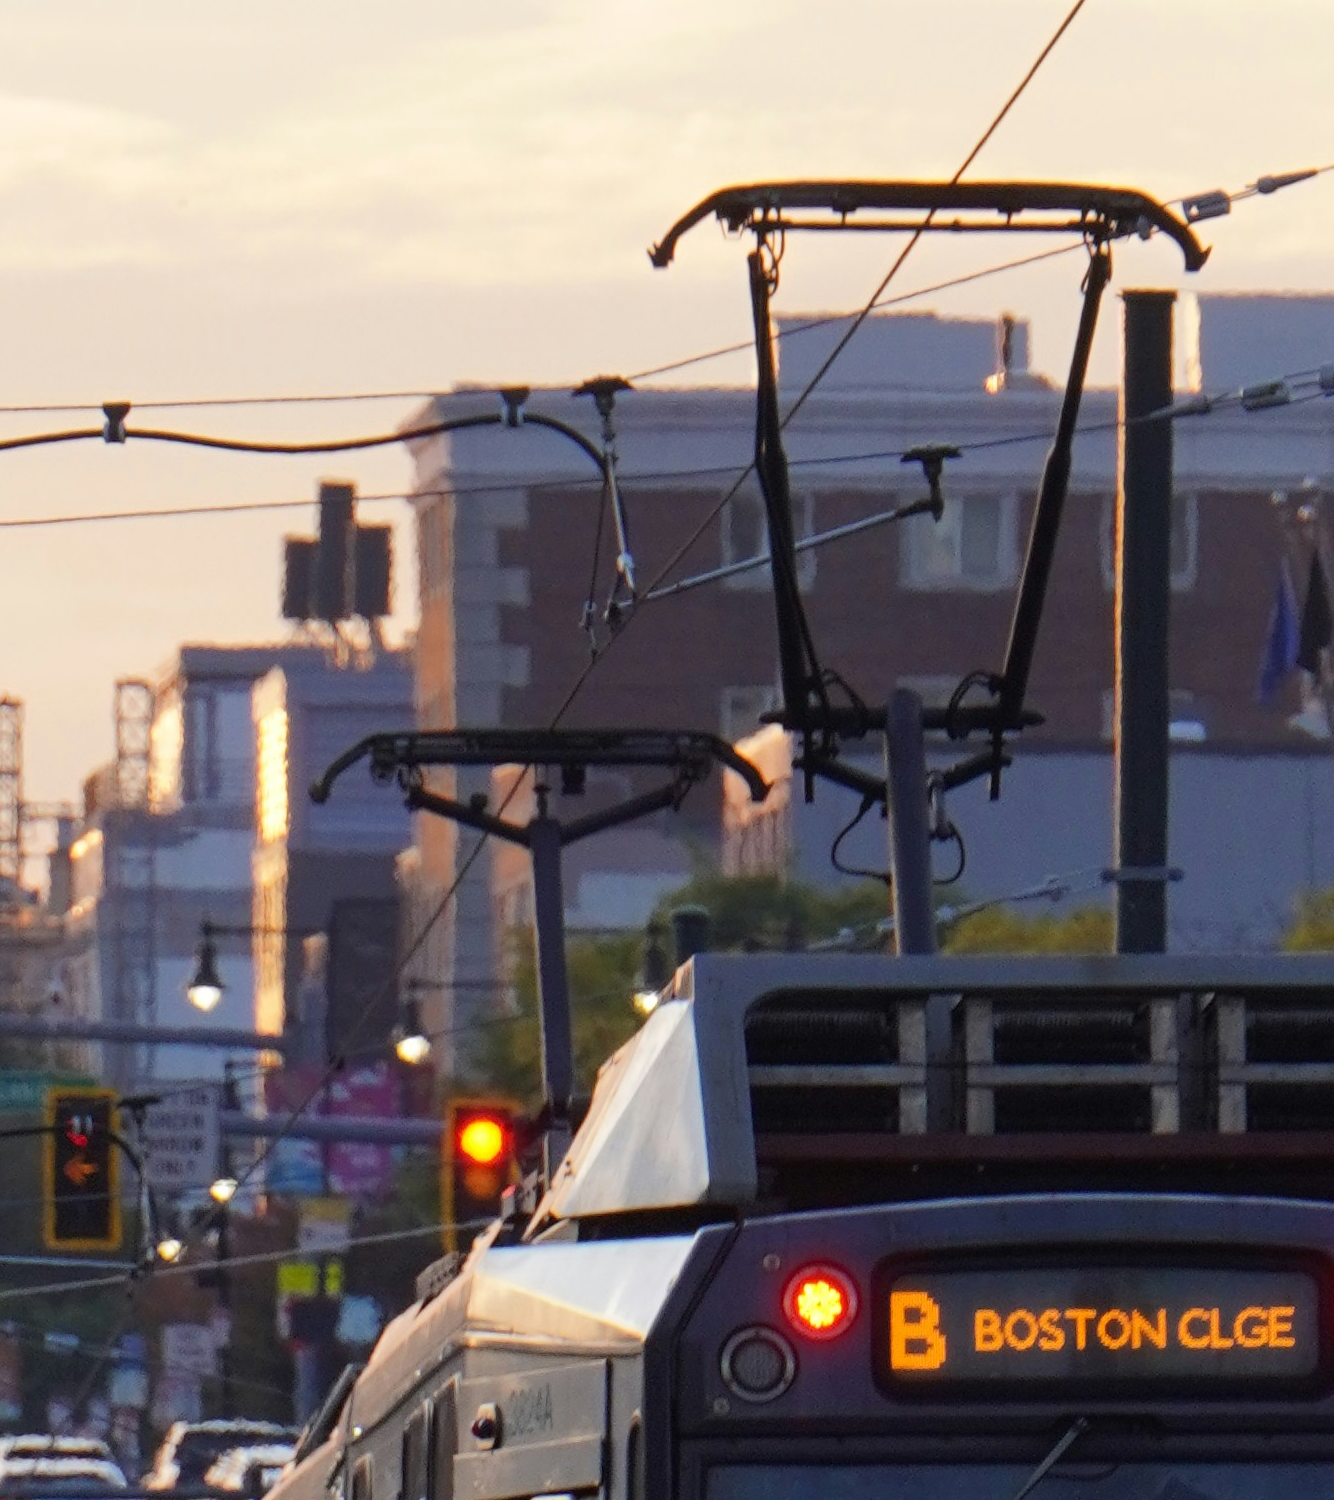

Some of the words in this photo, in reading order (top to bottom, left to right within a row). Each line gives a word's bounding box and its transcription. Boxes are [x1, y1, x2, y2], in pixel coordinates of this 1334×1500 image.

[889, 1291, 947, 1371] B
[973, 1307, 1168, 1353] BOSTON
[1177, 1305, 1296, 1350] CLGE
